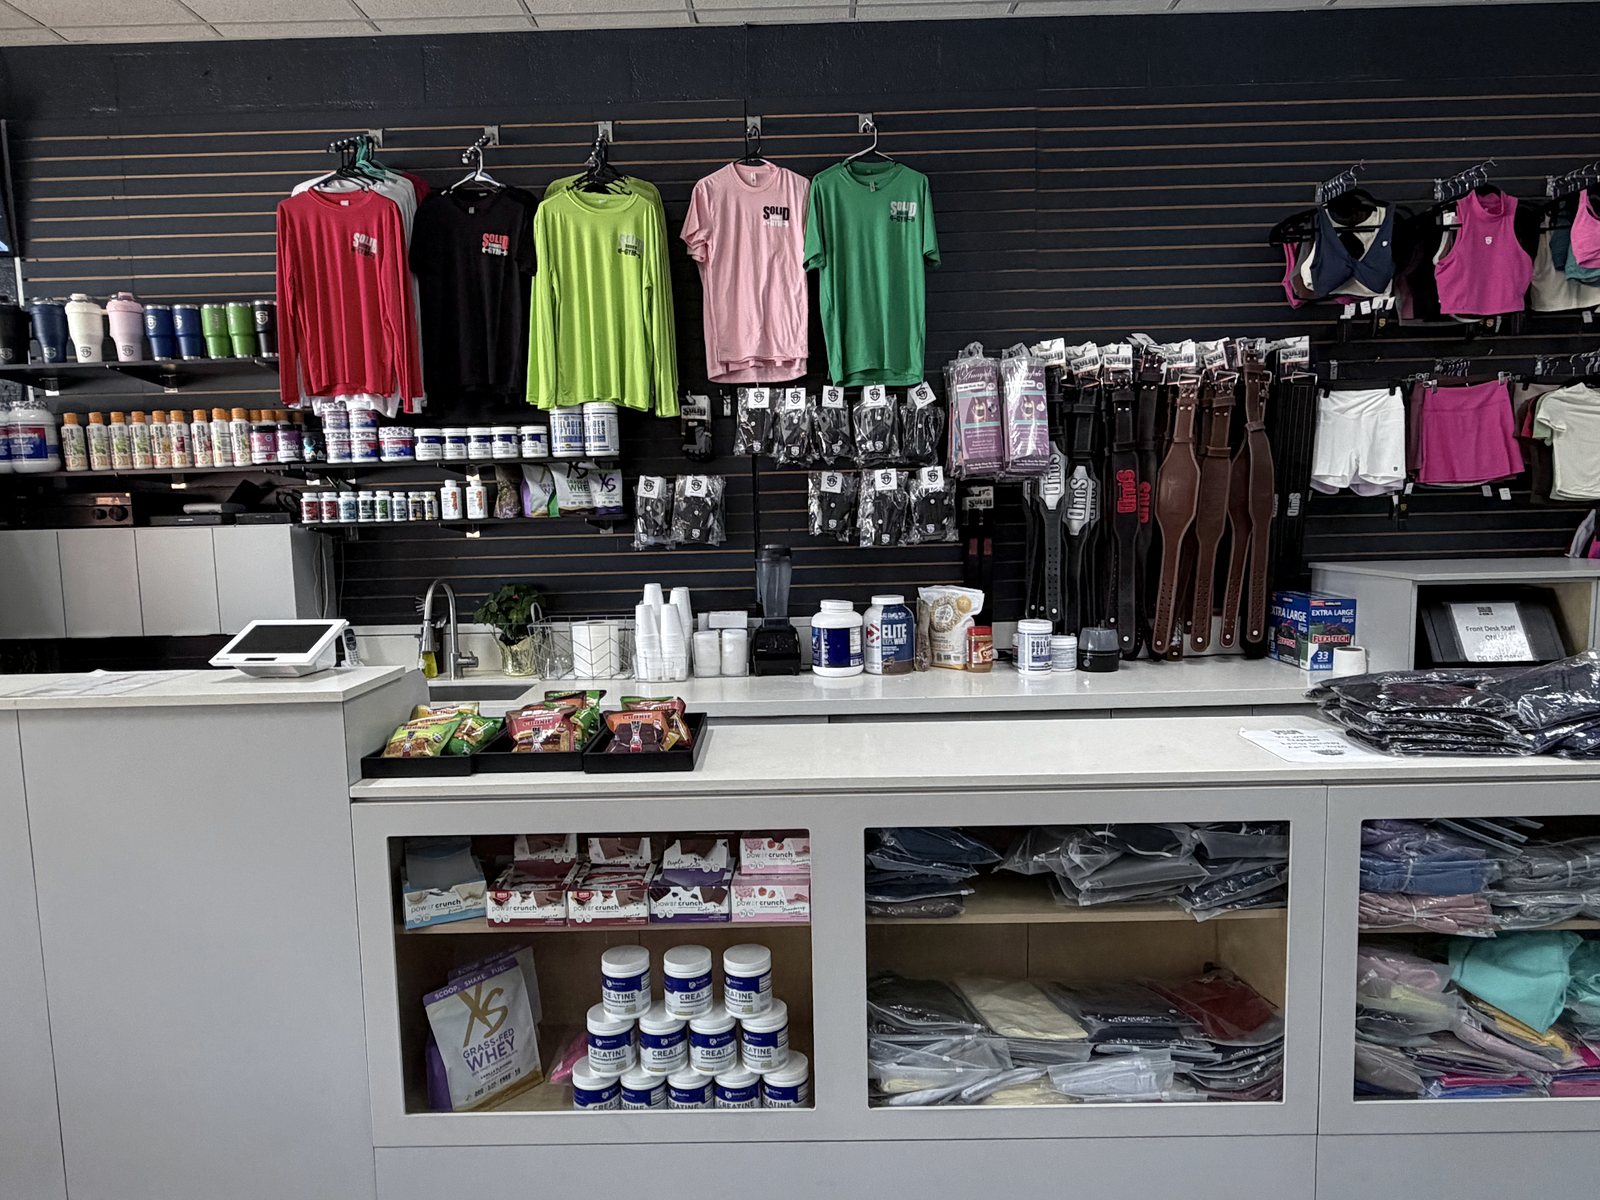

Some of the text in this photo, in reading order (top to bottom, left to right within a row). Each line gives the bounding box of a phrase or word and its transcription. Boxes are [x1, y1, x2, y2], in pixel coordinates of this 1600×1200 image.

[763, 206, 790, 221] SOLID
[891, 201, 917, 217] SOLID
[353, 232, 377, 254] SOLID
[482, 233, 509, 250] SOLID
[1072, 357, 1099, 371] SOLID
[1105, 355, 1132, 365] SOLID
[1066, 478, 1089, 520] SOLID
[1286, 608, 1308, 623] LARGE
[1311, 608, 1354, 617] EXTRA LARGE
[882, 623, 907, 639] ELITE
[1317, 651, 1329, 660] 33
[435, 898, 462, 909] crunch
[457, 981, 508, 1049] XS
[462, 1027, 515, 1059] GRASS-FED
[465, 1035, 515, 1072] WHEY
